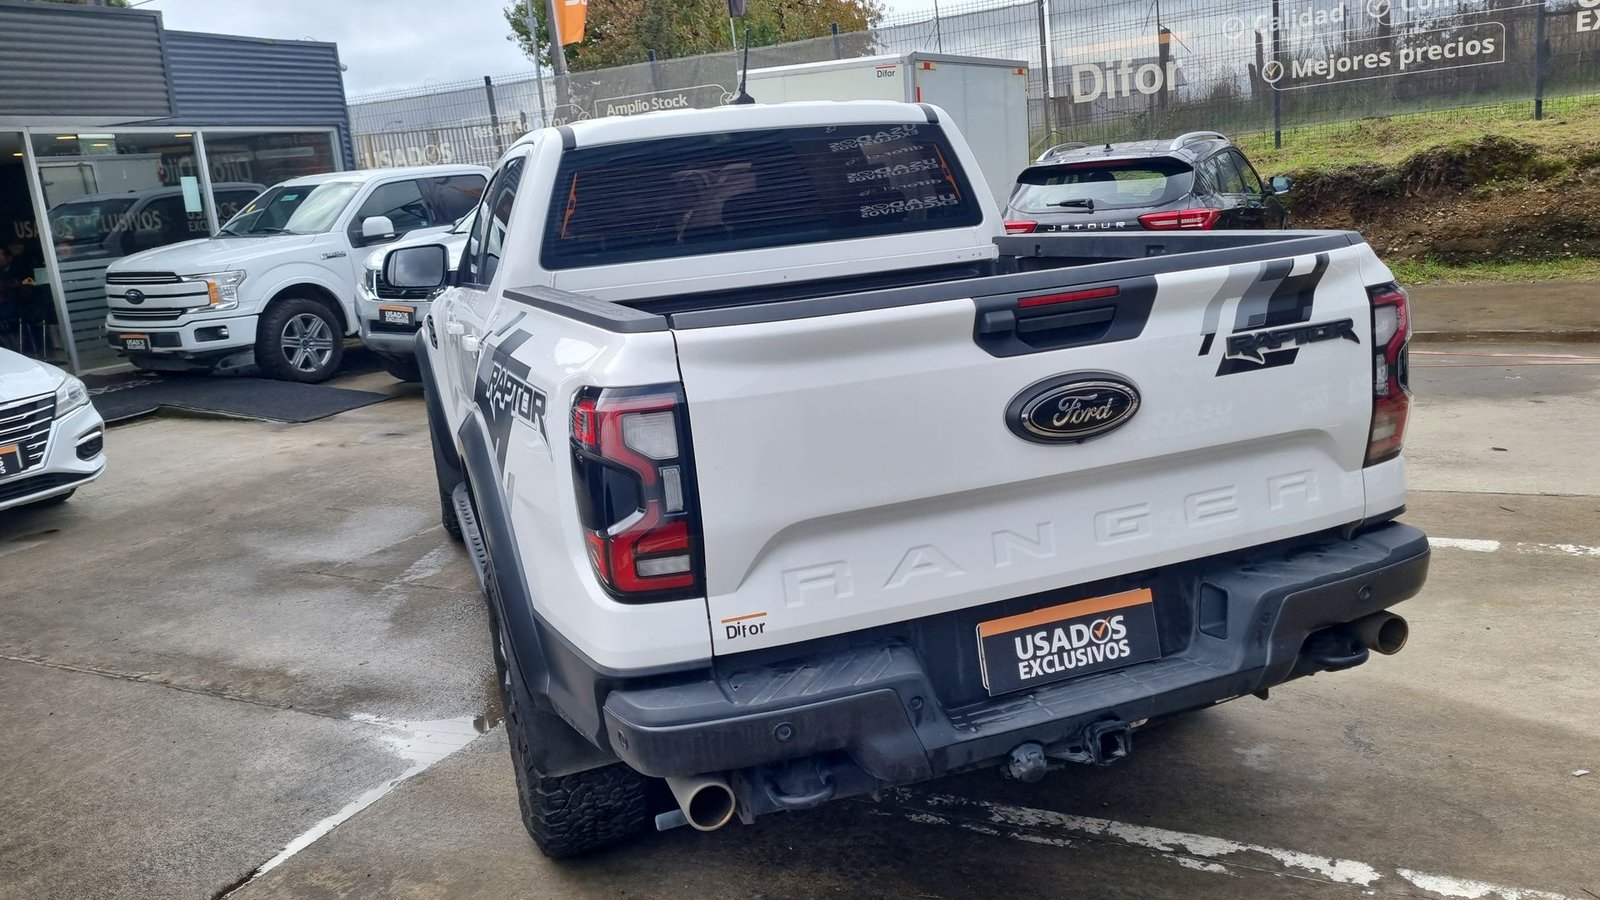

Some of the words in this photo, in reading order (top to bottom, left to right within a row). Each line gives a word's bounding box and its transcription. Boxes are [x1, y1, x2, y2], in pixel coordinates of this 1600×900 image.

[1254, 2, 1345, 33] Calidad
[876, 70, 896, 78] Difor
[1291, 51, 1392, 80] Mejores
[1399, 35, 1495, 70] precios
[1072, 57, 1188, 104] Difor
[606, 101, 650, 116] Amplio
[651, 93, 689, 112] Stock
[365, 142, 452, 169] USADOS
[1047, 221, 1127, 232] JETOUR
[1226, 318, 1360, 363] RAPTOR
[486, 362, 552, 456] RAPTOR
[1052, 393, 1113, 427] Ford
[781, 468, 1320, 609] RANGER
[726, 621, 766, 640] Difor
[1014, 615, 1127, 660] USADOS
[1018, 639, 1131, 680] EXCLUSIVOS
